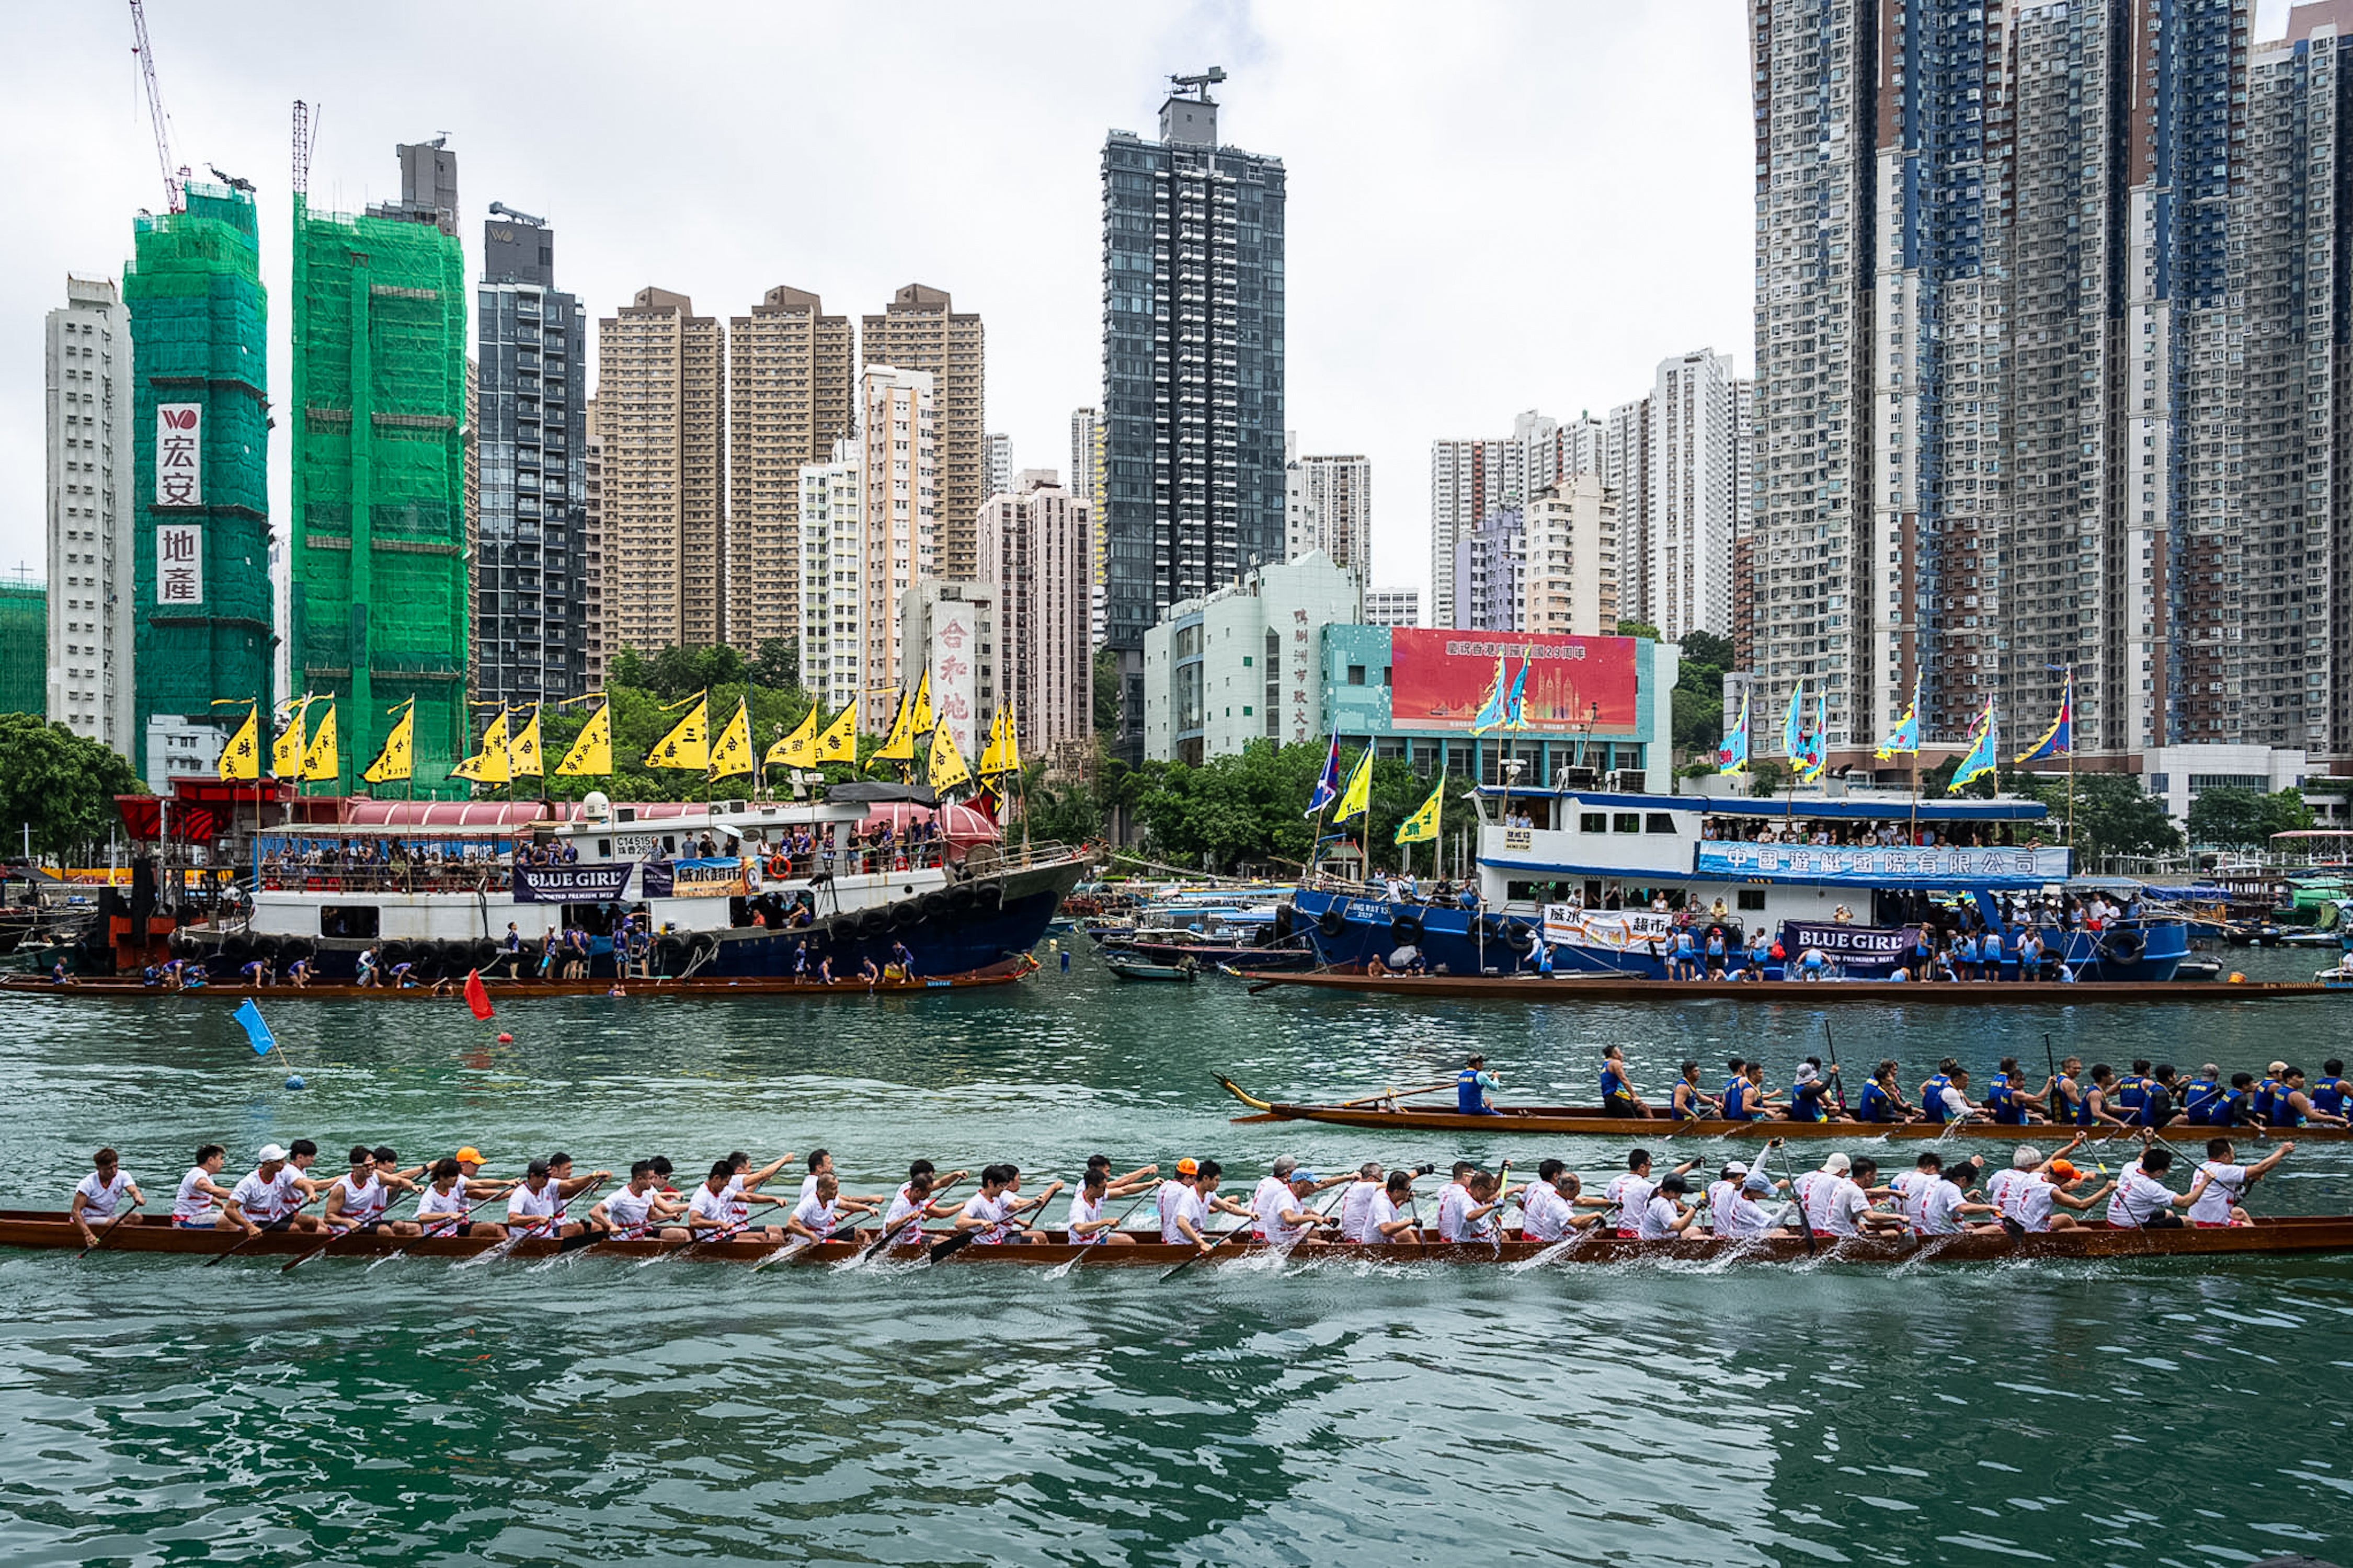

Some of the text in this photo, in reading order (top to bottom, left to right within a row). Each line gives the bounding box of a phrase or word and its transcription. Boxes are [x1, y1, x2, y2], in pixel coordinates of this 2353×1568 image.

[163, 435, 195, 599] 宏安 地產
[527, 872, 621, 887] BLUE GIRL
[1634, 917, 1666, 933] 超市
[1799, 931, 1902, 950] BLUE GIRL
